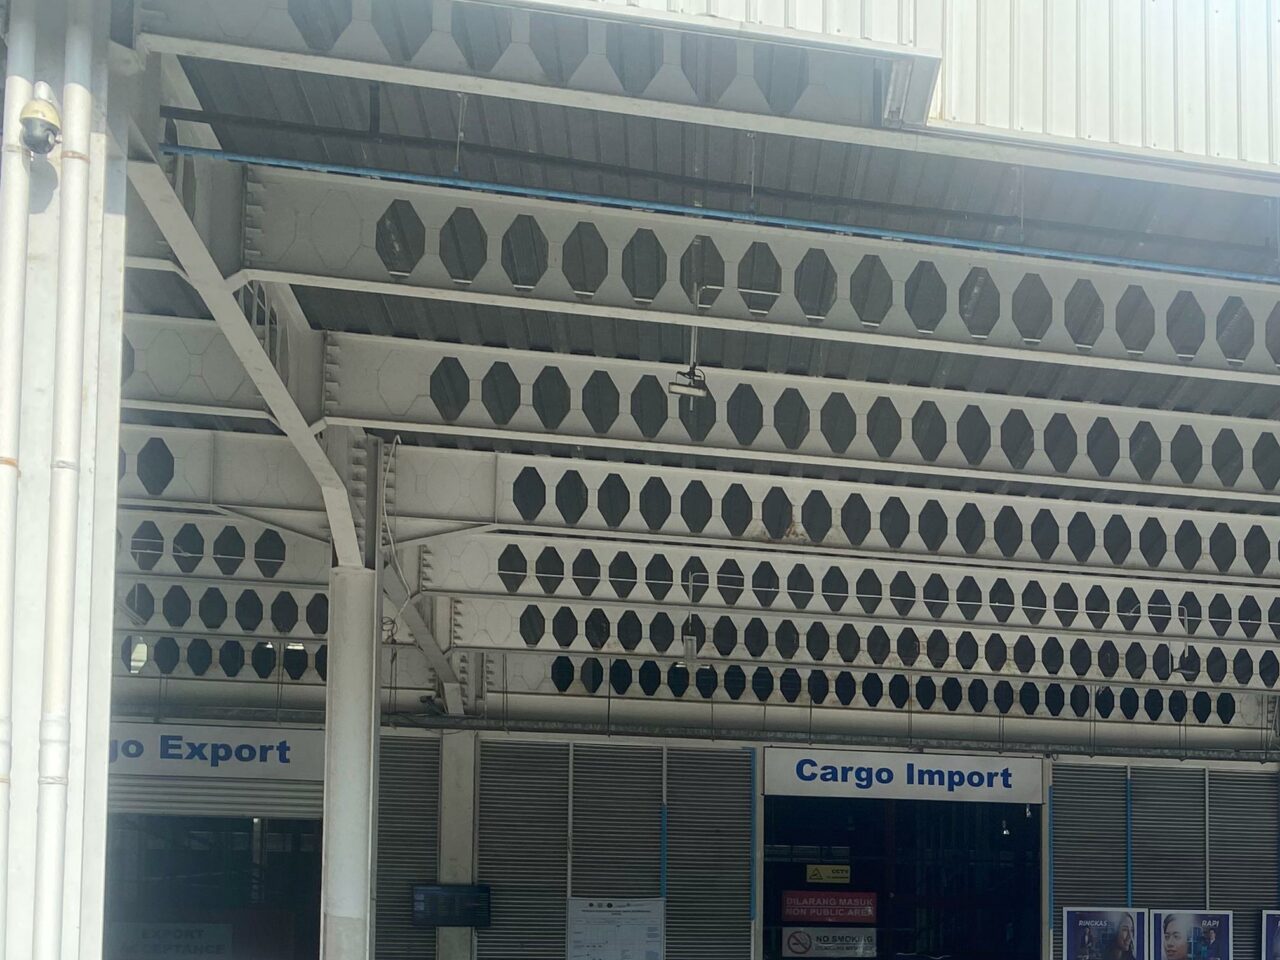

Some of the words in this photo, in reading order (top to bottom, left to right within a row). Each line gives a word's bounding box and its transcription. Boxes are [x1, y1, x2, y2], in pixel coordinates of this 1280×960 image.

[159, 735, 291, 767] Export
[795, 758, 894, 789] Cargo
[906, 763, 1013, 791] Import
[786, 897, 837, 906] DILARANG
[838, 898, 873, 906] MASUK
[809, 908, 845, 916] PUBLIC
[847, 909, 874, 917] AREA
[1078, 919, 1108, 927] RINGKAS
[1201, 919, 1220, 927] RAPI
[141, 928, 204, 939] EXPORT
